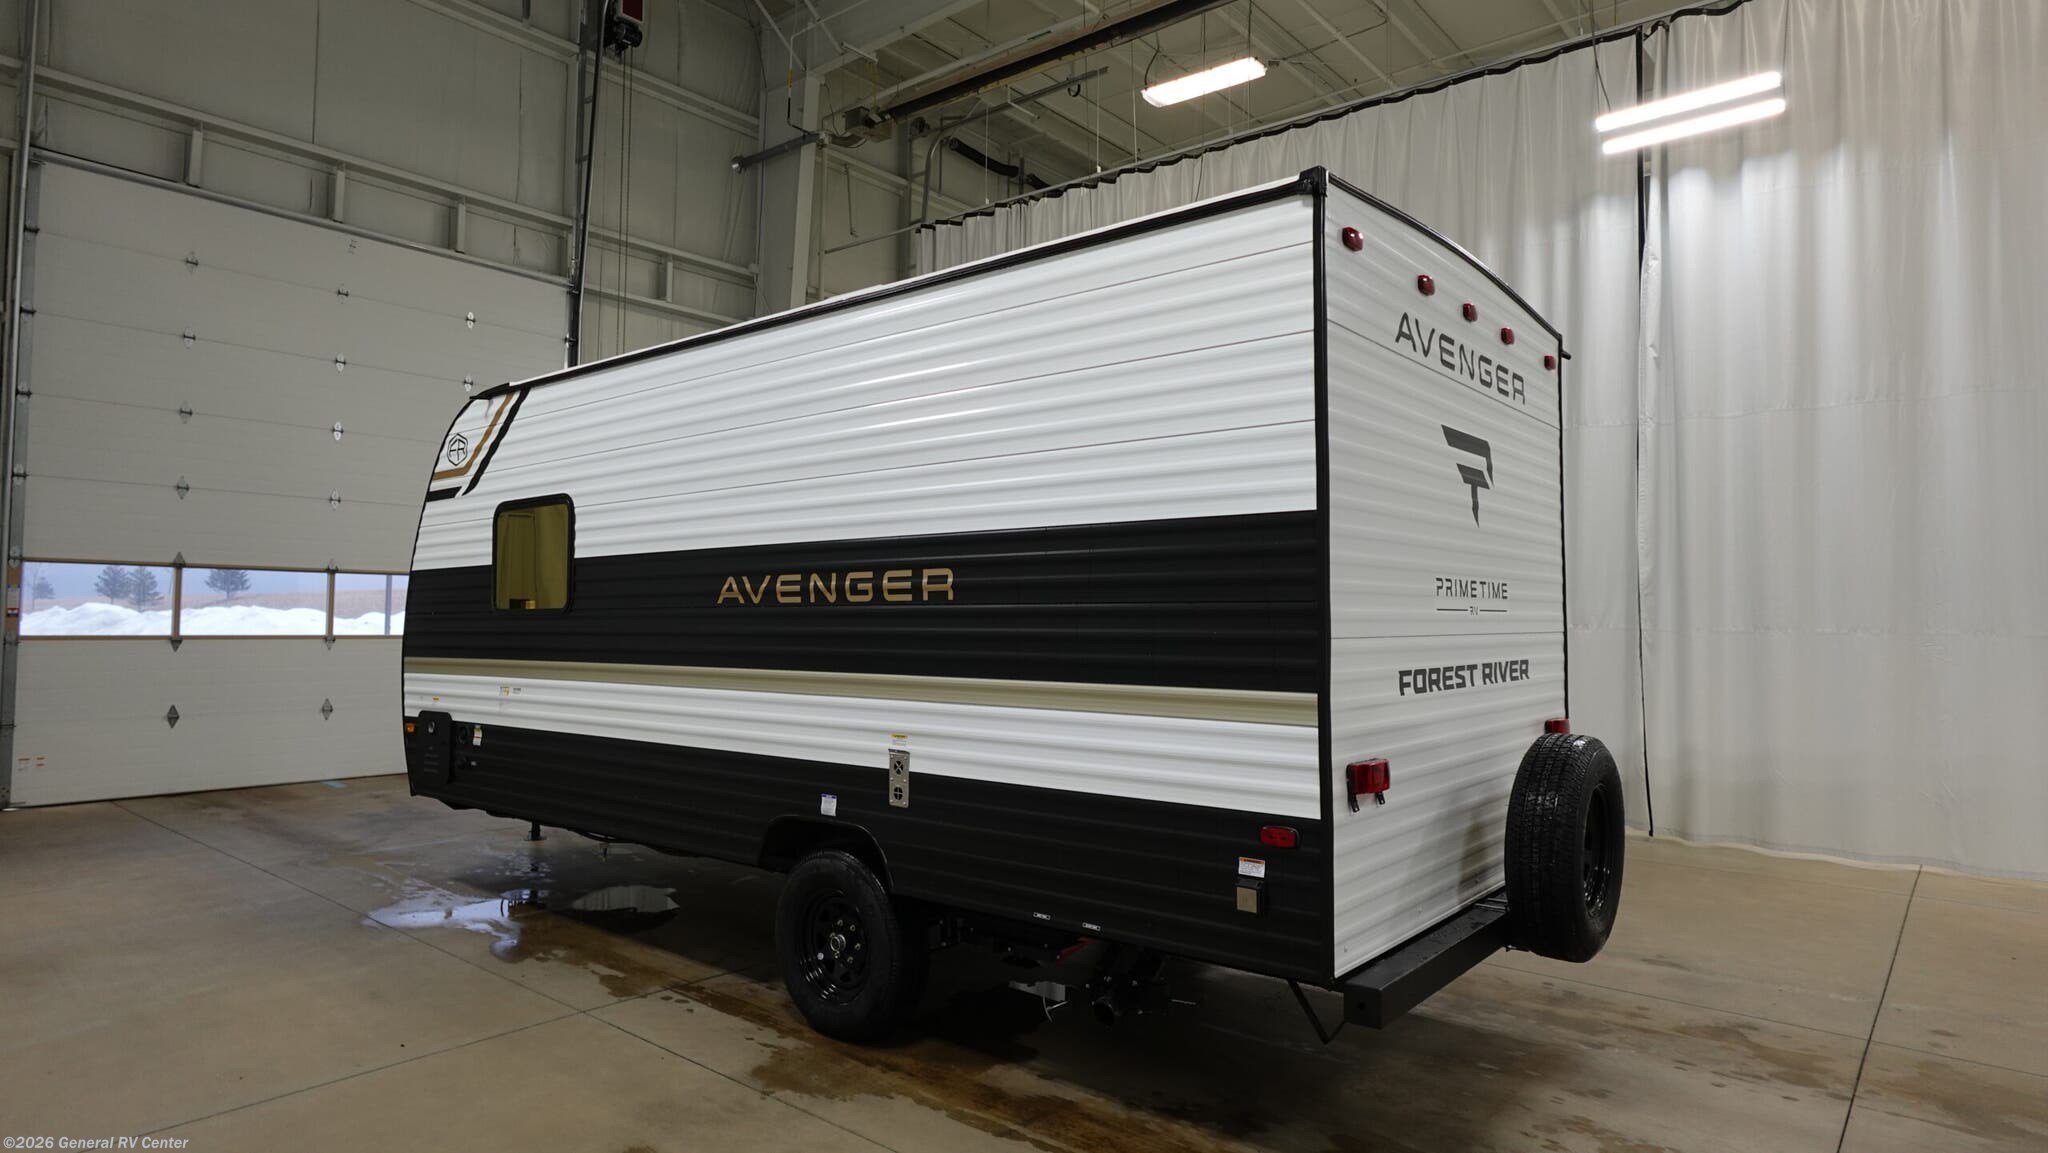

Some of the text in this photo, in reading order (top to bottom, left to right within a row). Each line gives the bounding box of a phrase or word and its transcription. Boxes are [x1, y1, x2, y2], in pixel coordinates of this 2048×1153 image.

[1395, 312, 1526, 405] AVENGER
[716, 567, 955, 604] AVENGER
[1398, 659, 1530, 696] FOREST RIVER
